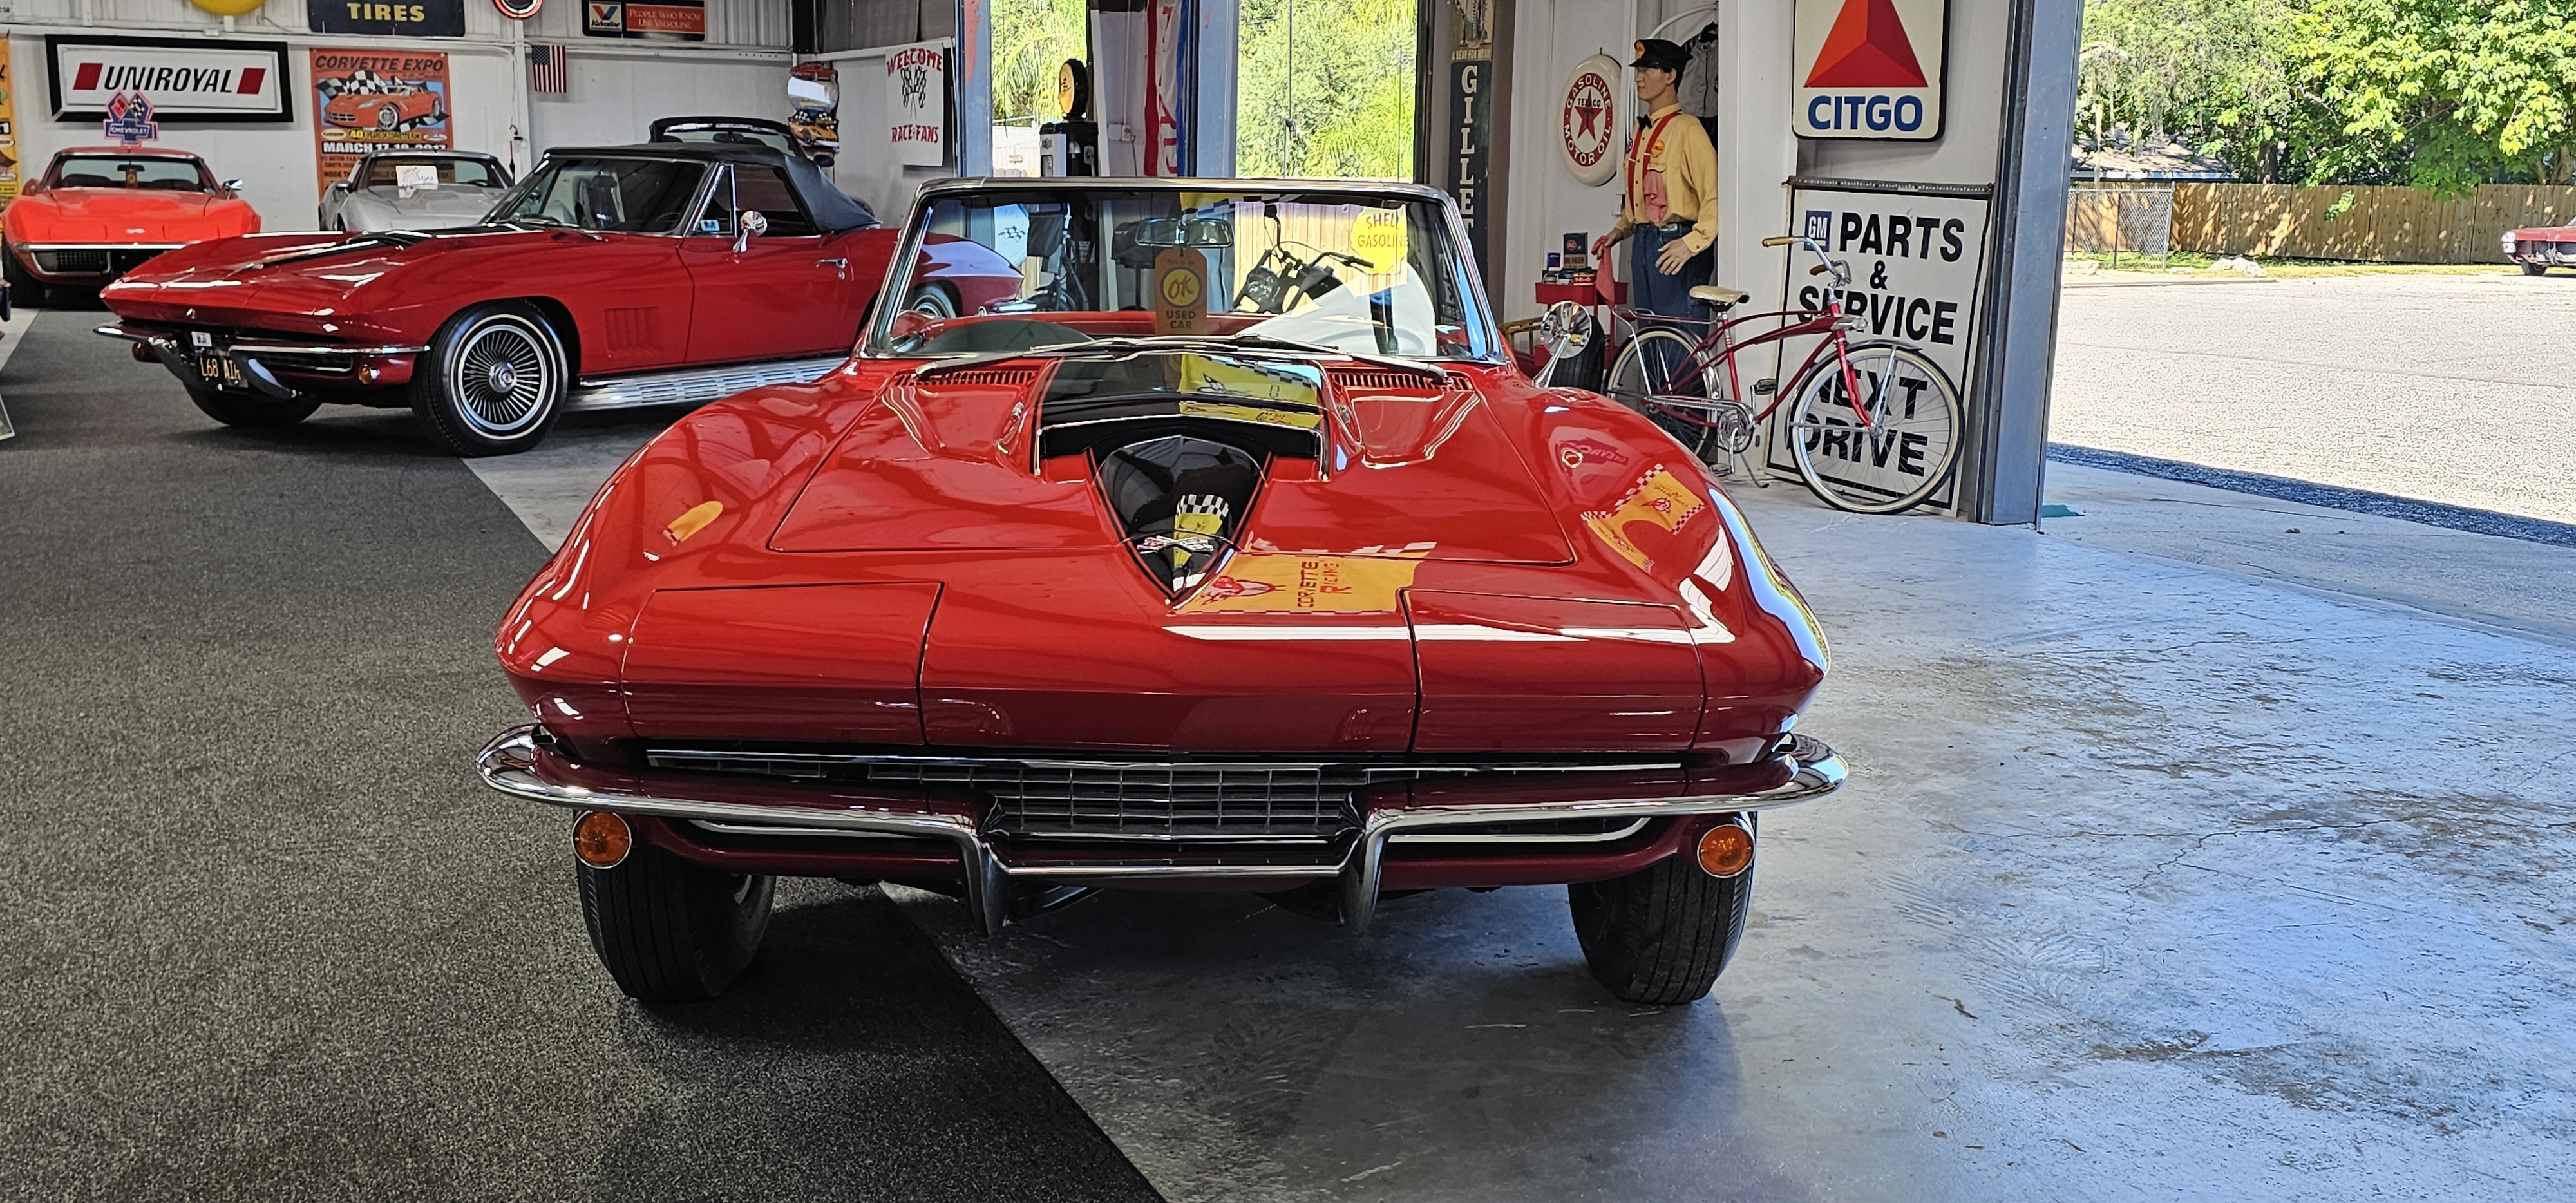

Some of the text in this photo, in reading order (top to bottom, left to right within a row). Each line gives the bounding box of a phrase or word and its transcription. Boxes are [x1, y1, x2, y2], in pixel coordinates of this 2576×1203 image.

[347, 3, 424, 22] TIRES
[315, 55, 444, 71] CORVETTE EXPO
[887, 48, 942, 77] WELCOME
[104, 66, 232, 93] UNIROYAL
[1566, 74, 1611, 109] GASOLINE
[1808, 95, 1924, 131] CITGO
[323, 142, 373, 153] MARCH
[350, 130, 363, 138] 40
[1564, 124, 1611, 165] MOTOR OIL
[1808, 211, 1965, 262] GM PARTS
[1167, 274, 1195, 299] OK
[1870, 260, 1888, 290] &
[1166, 311, 1196, 319] USED
[1170, 321, 1192, 330] CAR
[1799, 285, 1958, 345] SERVICE
[200, 356, 219, 377] L68
[1803, 413, 1928, 477] DRIVE
[1298, 561, 1318, 607] CORVETTE
